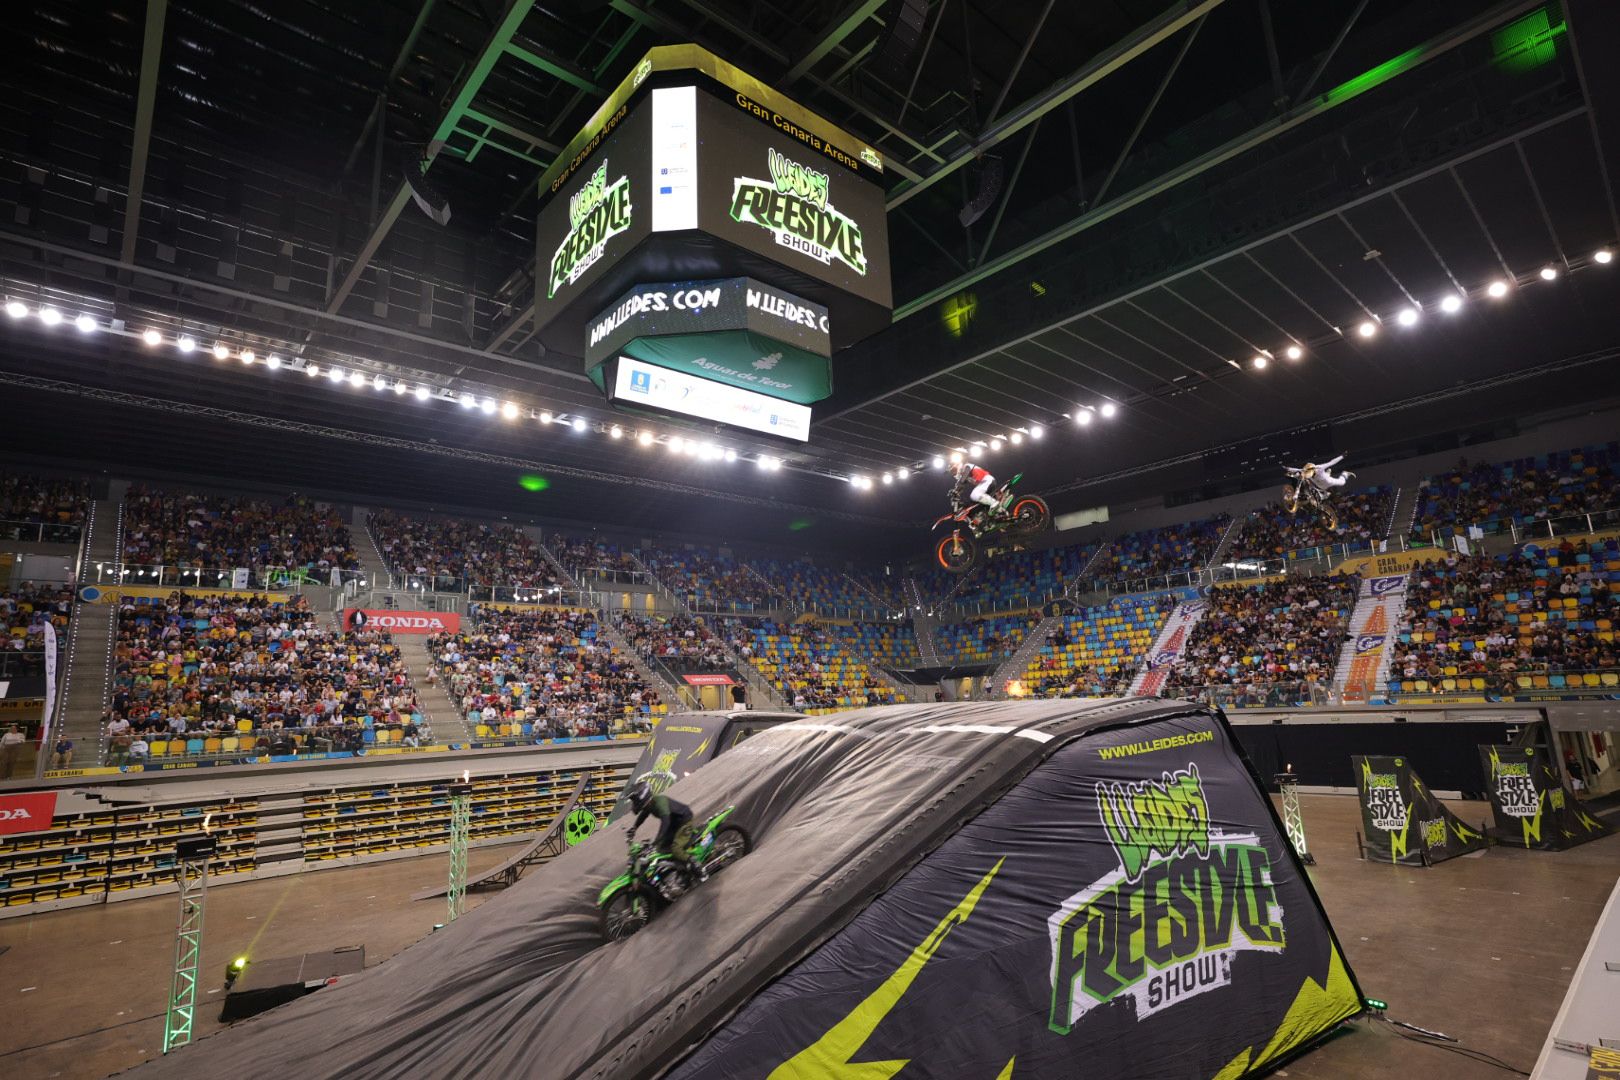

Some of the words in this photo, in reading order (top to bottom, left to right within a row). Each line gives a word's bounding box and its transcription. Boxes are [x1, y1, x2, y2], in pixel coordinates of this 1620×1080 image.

[736, 93, 769, 121] Gran
[773, 114, 821, 149] Canaria
[824, 143, 858, 170] Arena
[551, 169, 570, 193] Gran
[570, 135, 600, 171] Canaria
[601, 105, 628, 138] Arena
[548, 180, 631, 298] FREESTYLE
[730, 183, 866, 275] FREESTYLE
[782, 233, 823, 259] SHOW
[573, 248, 600, 279] SHOW
[691, 357, 737, 375] Aguas
[737, 371, 758, 382] de
[1377, 557, 1397, 567] GRAN
[364, 615, 445, 629] HONDA
[1098, 730, 1214, 760] WWW.LLEIDES.COM
[1371, 789, 1400, 803] FREE
[1500, 776, 1532, 791] FREE
[1370, 802, 1405, 820] STYLE
[1500, 790, 1537, 806] STYLE
[1377, 819, 1404, 827] SHOW
[1048, 843, 1287, 1035] FREESTYLE
[1148, 952, 1218, 1007] SHOW
